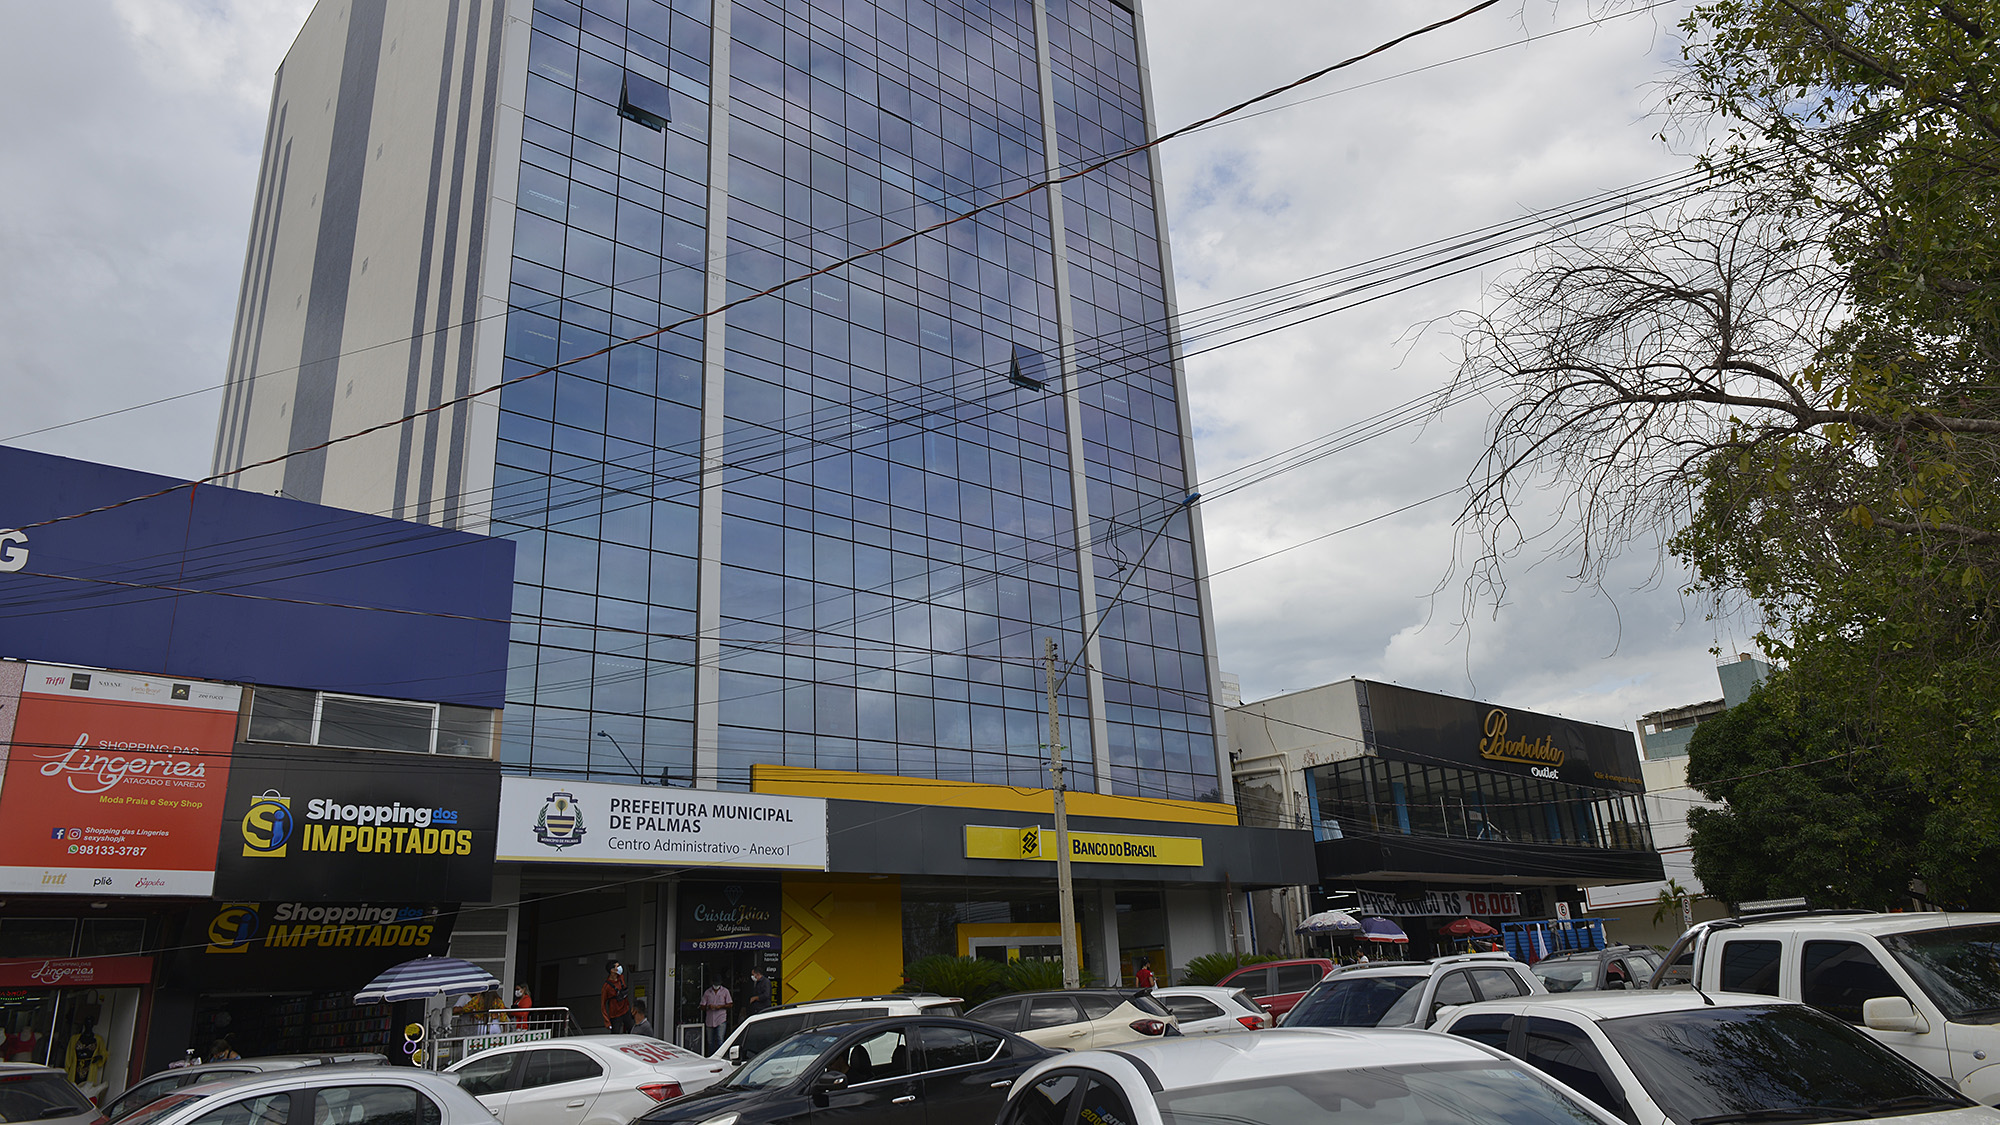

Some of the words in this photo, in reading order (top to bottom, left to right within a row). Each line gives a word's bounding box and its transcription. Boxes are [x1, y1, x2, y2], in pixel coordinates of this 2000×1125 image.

[99, 740, 169, 753] SHOPPING
[173, 745, 200, 755] DAS
[1479, 709, 1565, 767] Borboleta
[34, 733, 206, 794] Lingeries
[1531, 767, 1560, 779] Outlet
[122, 777, 163, 786] ATACADO
[172, 780, 206, 788] VAREJO
[99, 796, 124, 804] Moda
[126, 797, 149, 805] Praia
[158, 798, 179, 808] Sexy
[180, 799, 203, 809] Shop
[610, 798, 708, 817] PREFEITURA
[712, 805, 793, 822] MUNICIPAL
[306, 799, 432, 827] Shopping
[432, 807, 458, 820] dos
[85, 826, 121, 836] Shopping
[136, 829, 170, 837] Lingeries
[609, 815, 631, 830] DE
[636, 817, 701, 833] PALMAS
[302, 824, 472, 855] IMPORTADOS
[608, 836, 650, 850] Centro
[653, 838, 740, 854] Administrativo
[749, 843, 784, 856] Anexo
[1072, 839, 1108, 855] BANCO
[1109, 843, 1122, 856] DO
[1123, 842, 1157, 857] BRASIL
[79, 845, 147, 856] 98133-3787
[41, 871, 67, 884] intt
[273, 903, 398, 924] Shopping
[397, 908, 424, 919] dos
[694, 904, 737, 921] Cristal
[736, 904, 770, 925] Jóias
[264, 925, 434, 948] IMPORTADOS
[699, 941, 706, 949] 63
[31, 960, 94, 984] Lingeries
